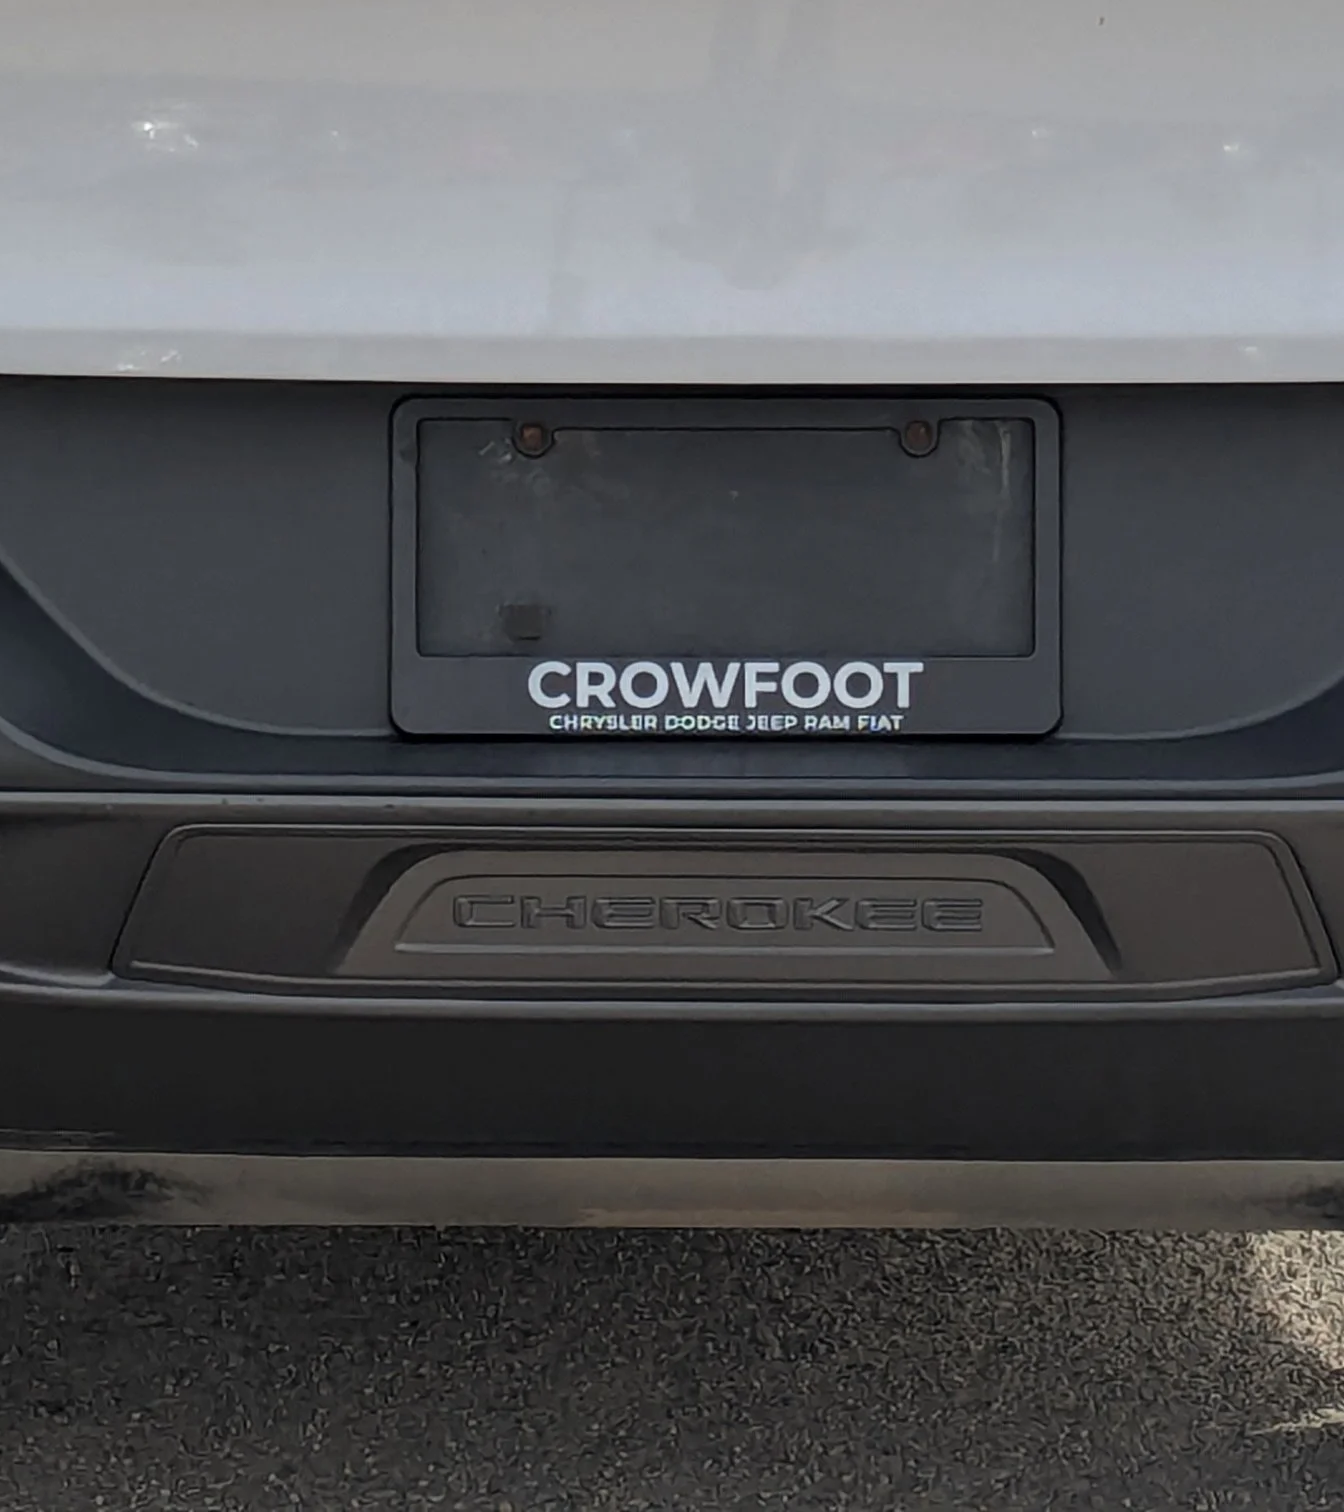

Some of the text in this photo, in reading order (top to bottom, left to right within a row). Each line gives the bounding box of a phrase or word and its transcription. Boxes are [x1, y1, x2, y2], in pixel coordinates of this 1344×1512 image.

[527, 661, 924, 709] CROWFOOT
[549, 715, 904, 730] CHRYSLER DODGE JEEP RAM FIAT
[451, 893, 986, 932] CHEROKEE
